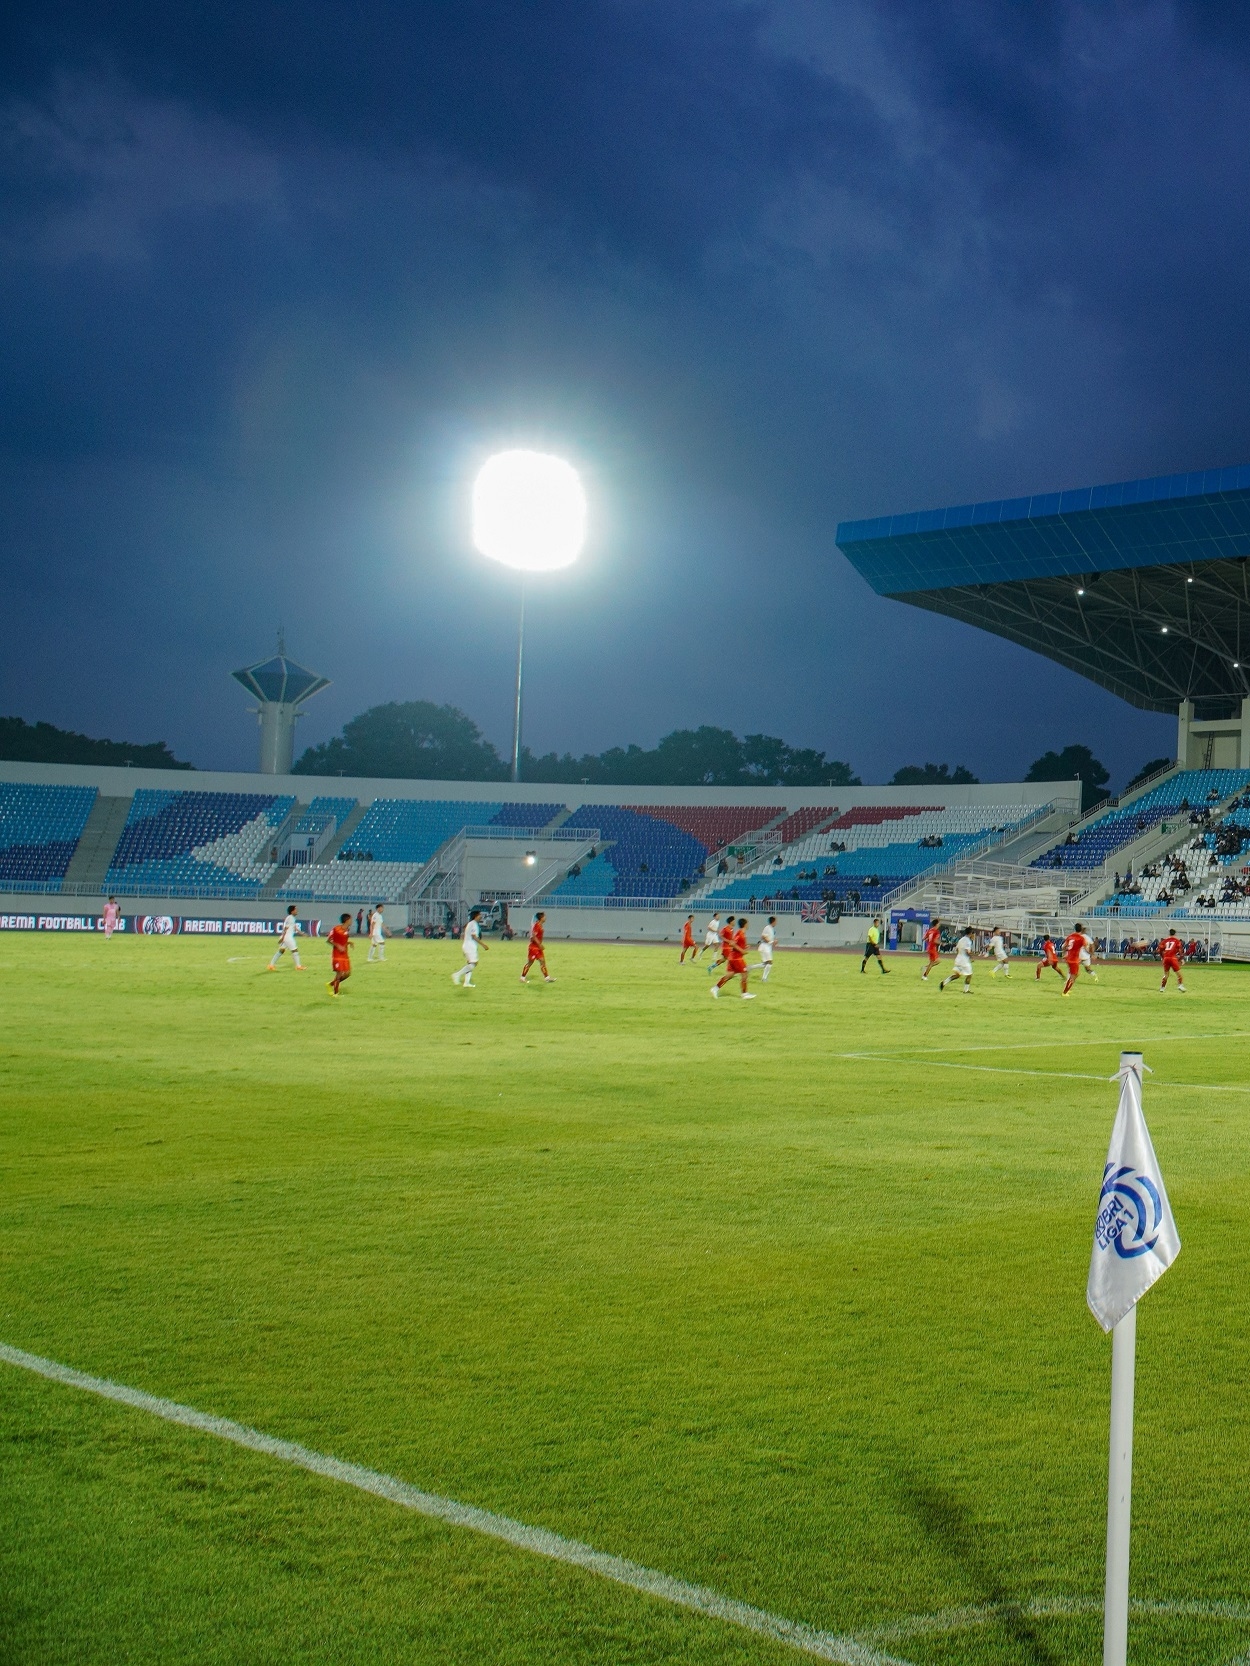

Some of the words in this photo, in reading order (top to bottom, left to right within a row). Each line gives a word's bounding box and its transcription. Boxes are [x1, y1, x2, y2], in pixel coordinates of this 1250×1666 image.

[0, 915, 36, 929] REMA
[37, 916, 95, 930] FOOTBALL
[96, 917, 126, 931] CB
[184, 919, 222, 932] AREMA
[224, 920, 274, 934] FOOTBALL
[276, 921, 302, 934] CB
[1165, 941, 1175, 951] 17
[1102, 1194, 1124, 1226] BRI
[1098, 1217, 1128, 1251] LIGA
[1123, 1208, 1135, 1220] 1
